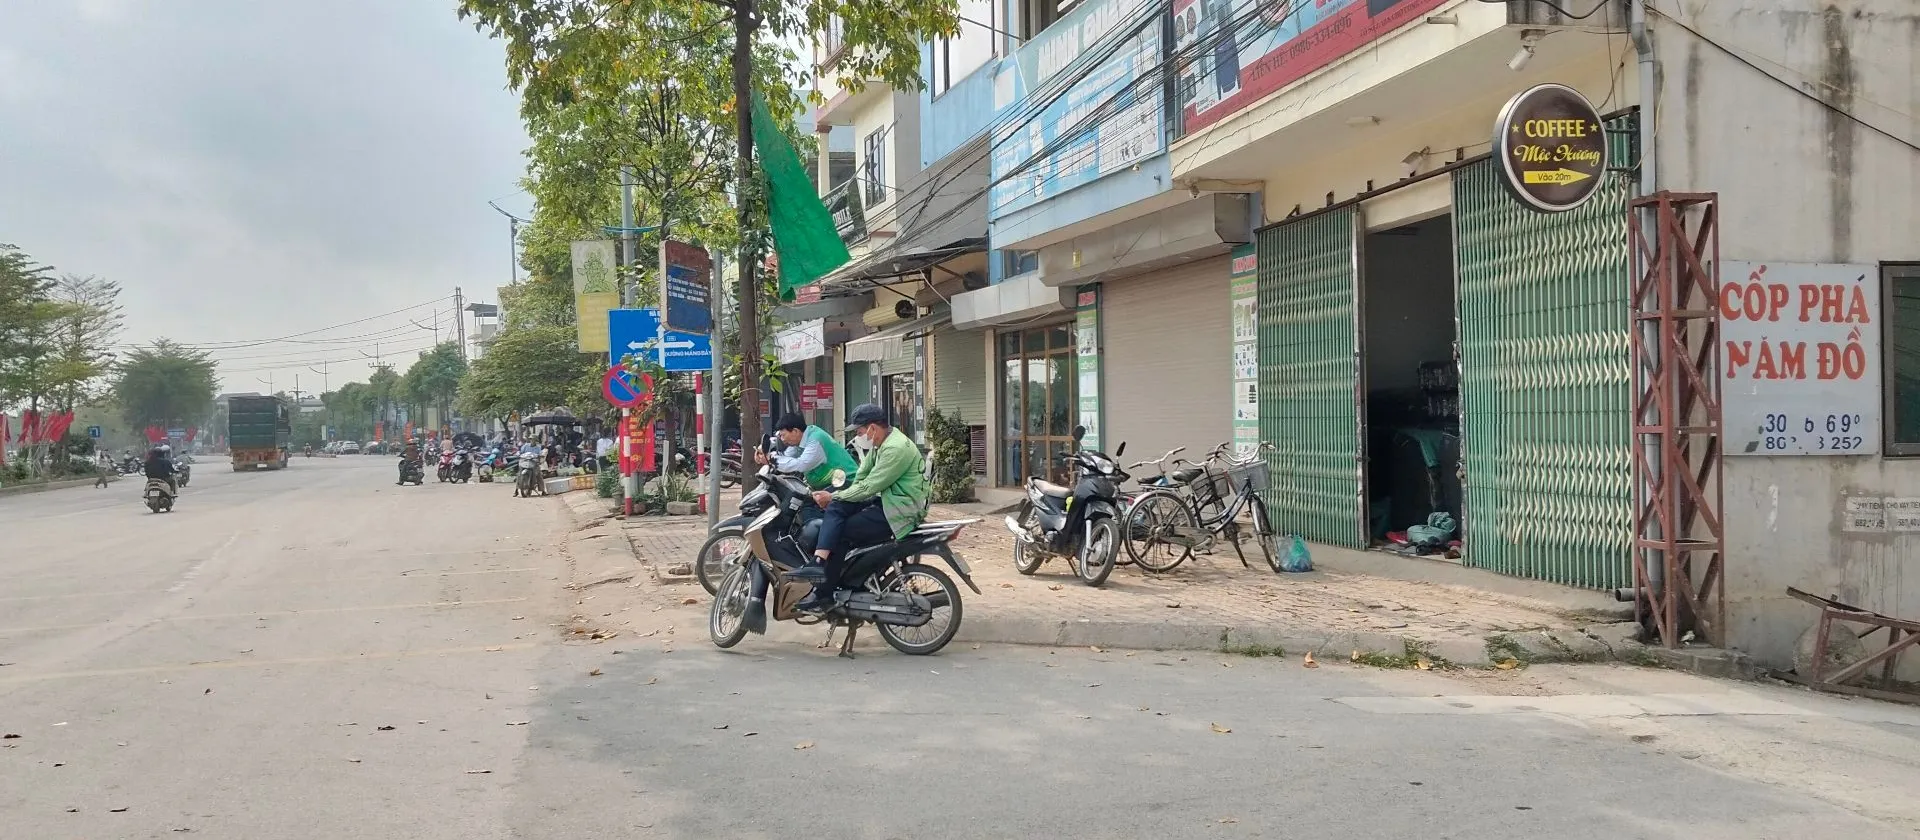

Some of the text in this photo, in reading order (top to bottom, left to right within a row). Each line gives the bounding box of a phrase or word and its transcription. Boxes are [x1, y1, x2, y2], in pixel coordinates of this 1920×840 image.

[1525, 119, 1586, 138] COFFEE
[1513, 144, 1551, 163] Mộc
[1537, 173, 1571, 181] Vào 20m
[1720, 264, 1790, 322] CỐP
